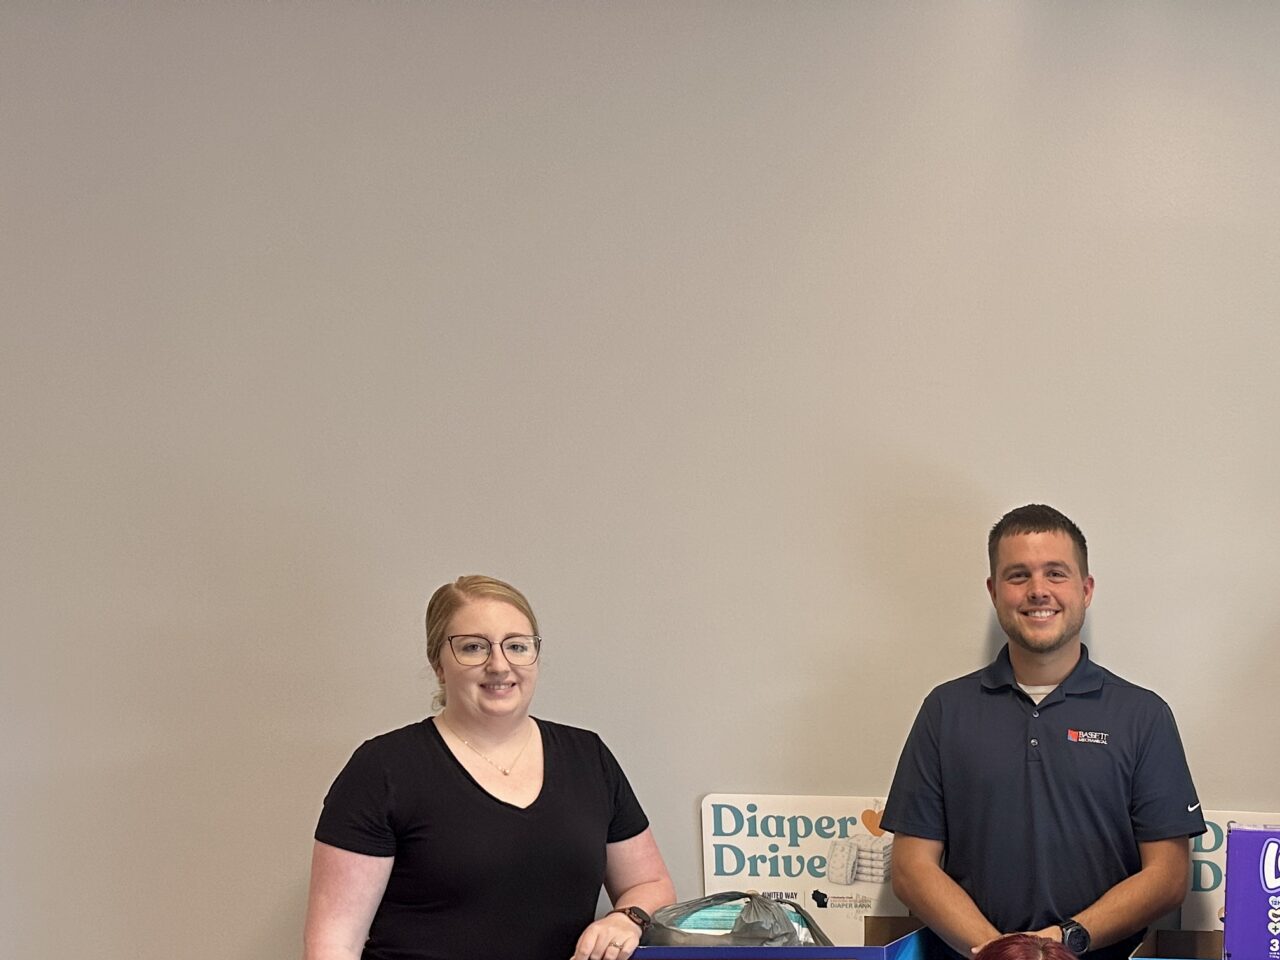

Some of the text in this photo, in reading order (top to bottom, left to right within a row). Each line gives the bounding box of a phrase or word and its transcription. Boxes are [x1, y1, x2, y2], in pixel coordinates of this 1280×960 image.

[711, 803, 857, 847] Diaper
[712, 843, 827, 878] Drive
[1269, 938, 1280, 951] 3
